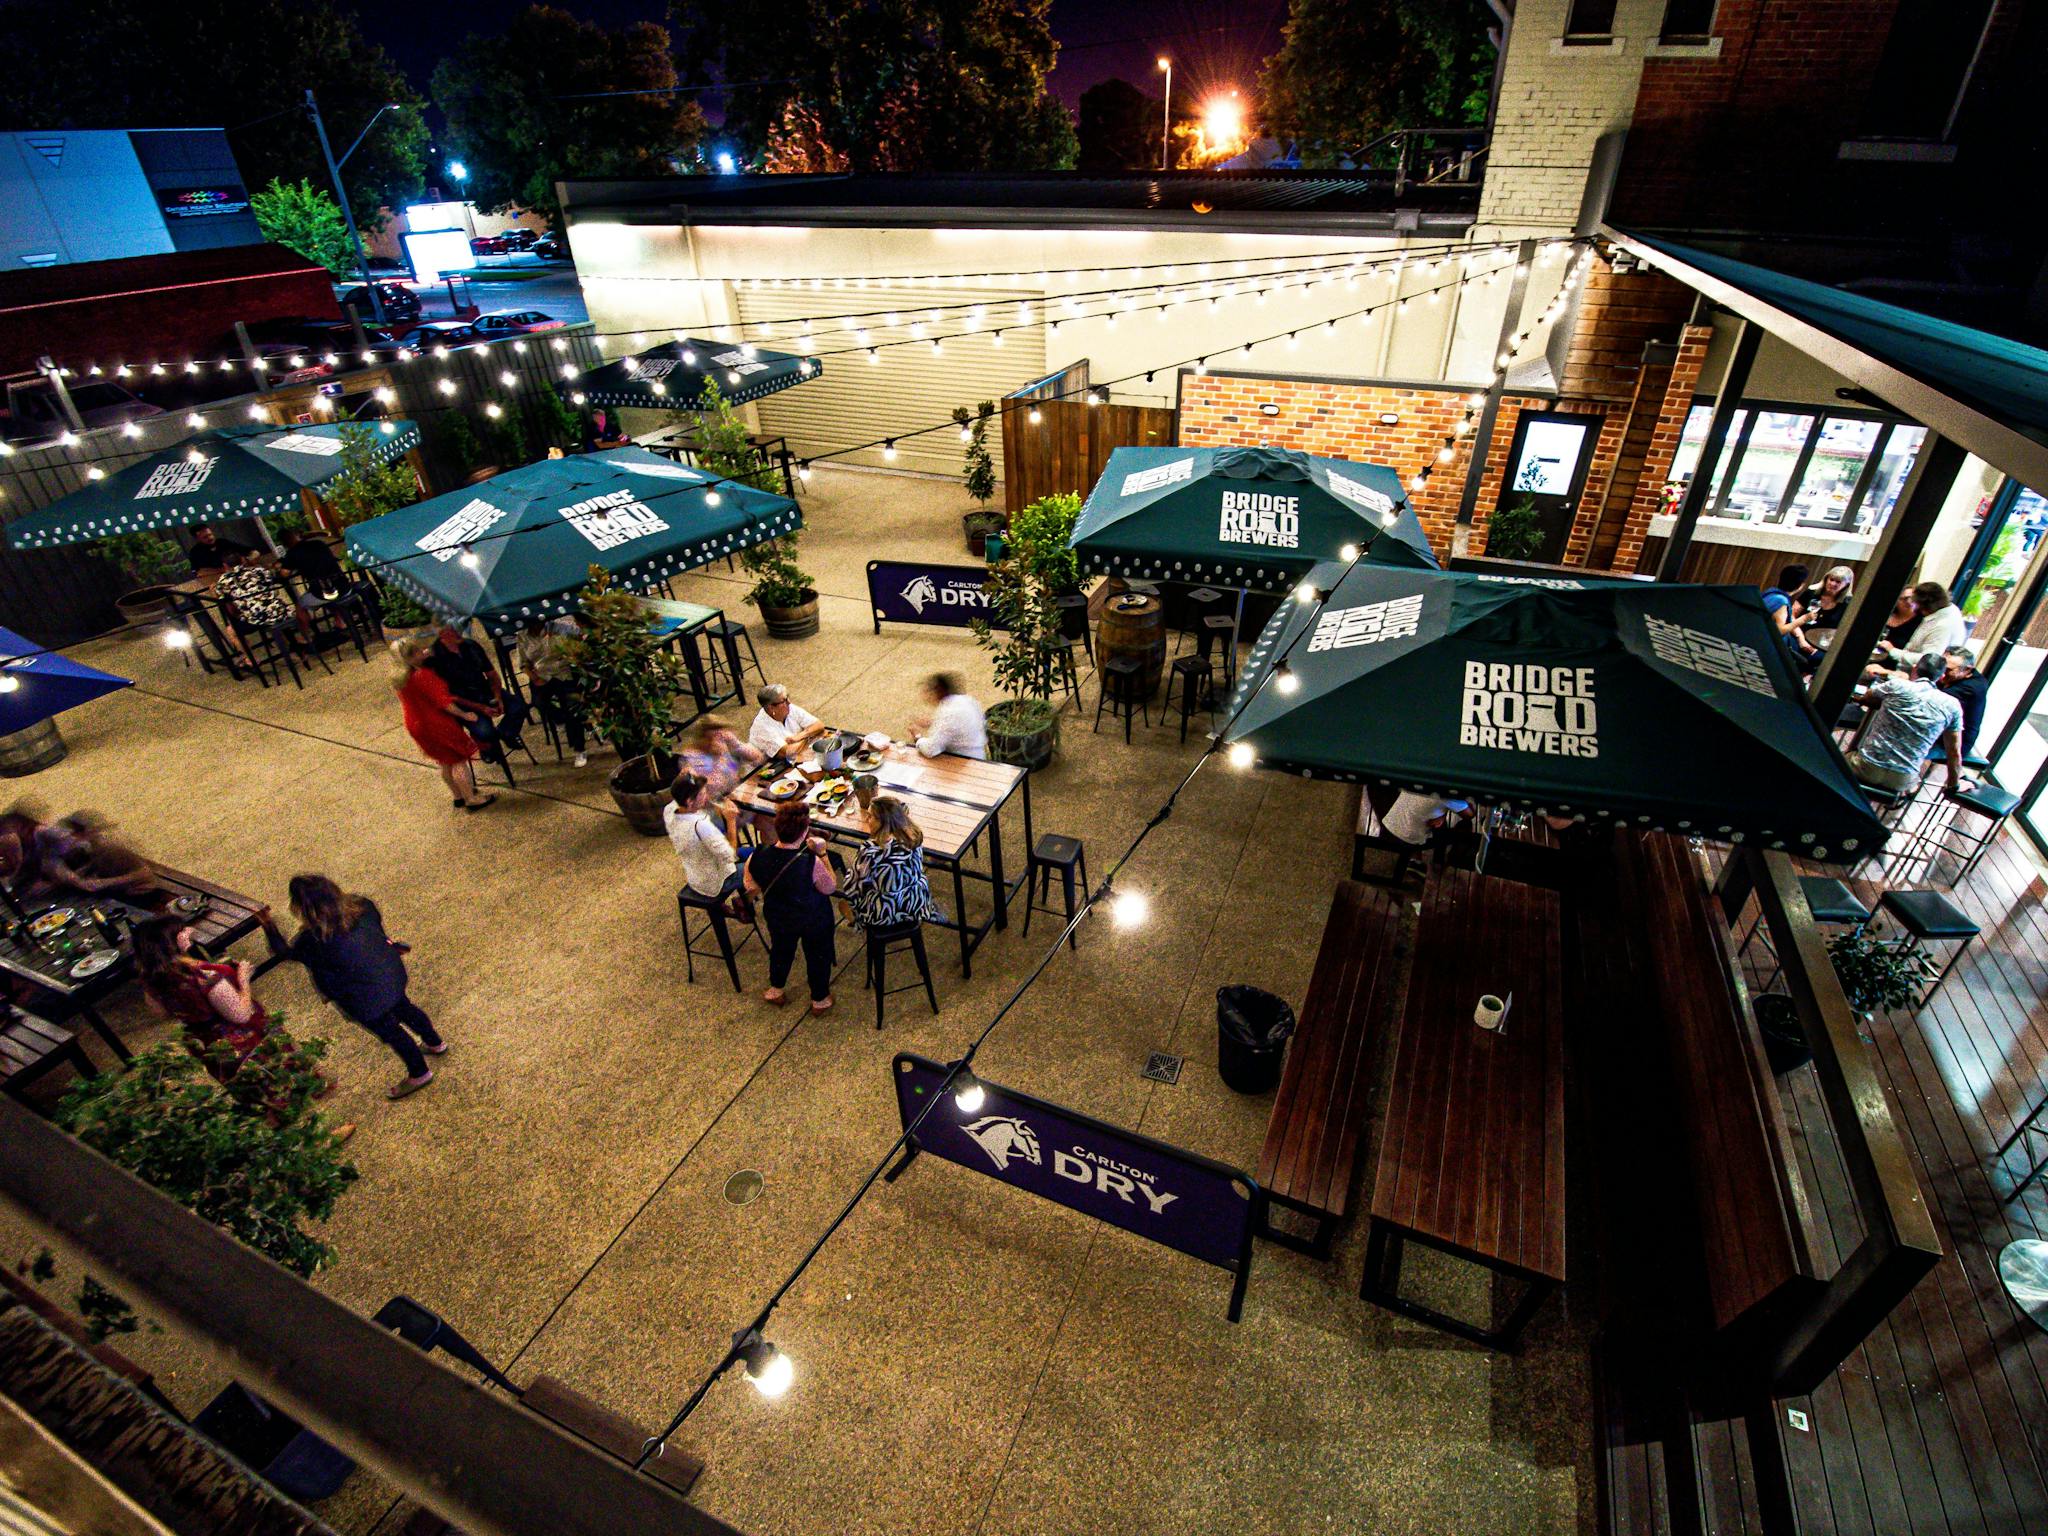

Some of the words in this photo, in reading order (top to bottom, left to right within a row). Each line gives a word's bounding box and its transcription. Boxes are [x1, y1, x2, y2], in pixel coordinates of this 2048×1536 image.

[133, 484, 203, 500] BREWERS
[1222, 490, 1299, 515] BRIDGE
[1219, 529, 1299, 549] BREWERS
[940, 588, 993, 608] DRY
[1464, 660, 1596, 697] BRIDGE
[1459, 723, 1600, 759] BREWERS
[1071, 1144, 1156, 1185] CARLTON
[1053, 1149, 1180, 1215] DRY
